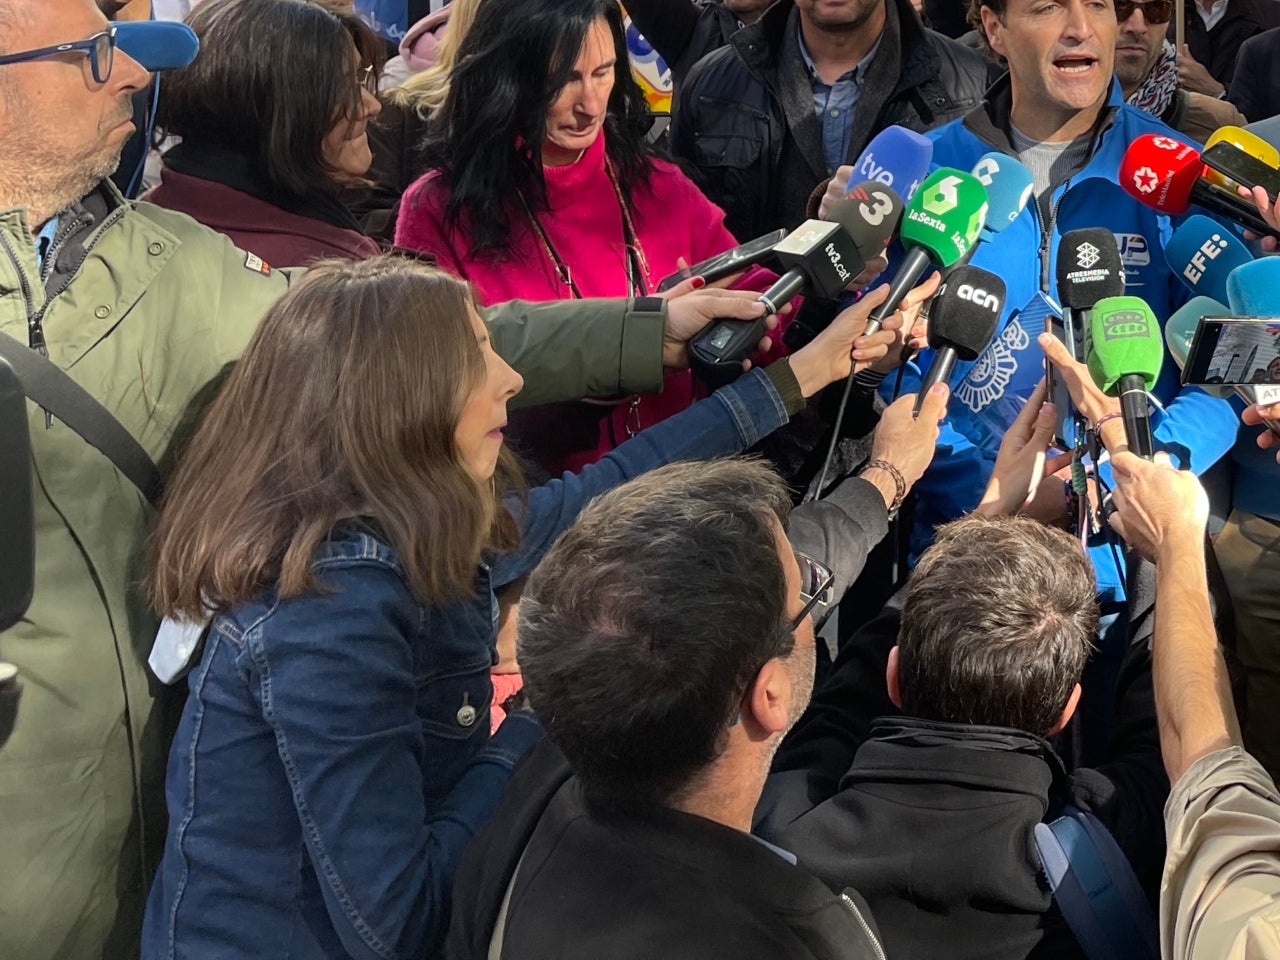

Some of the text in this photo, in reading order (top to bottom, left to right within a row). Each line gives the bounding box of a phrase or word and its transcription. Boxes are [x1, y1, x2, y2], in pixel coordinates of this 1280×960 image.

[860, 152, 894, 188] tve
[908, 209, 947, 232] laSexta
[824, 242, 851, 282] tv3.cat
[1066, 268, 1110, 280] ATRESMEDIA
[957, 283, 999, 313] acn
[1111, 324, 1144, 333] CERO
